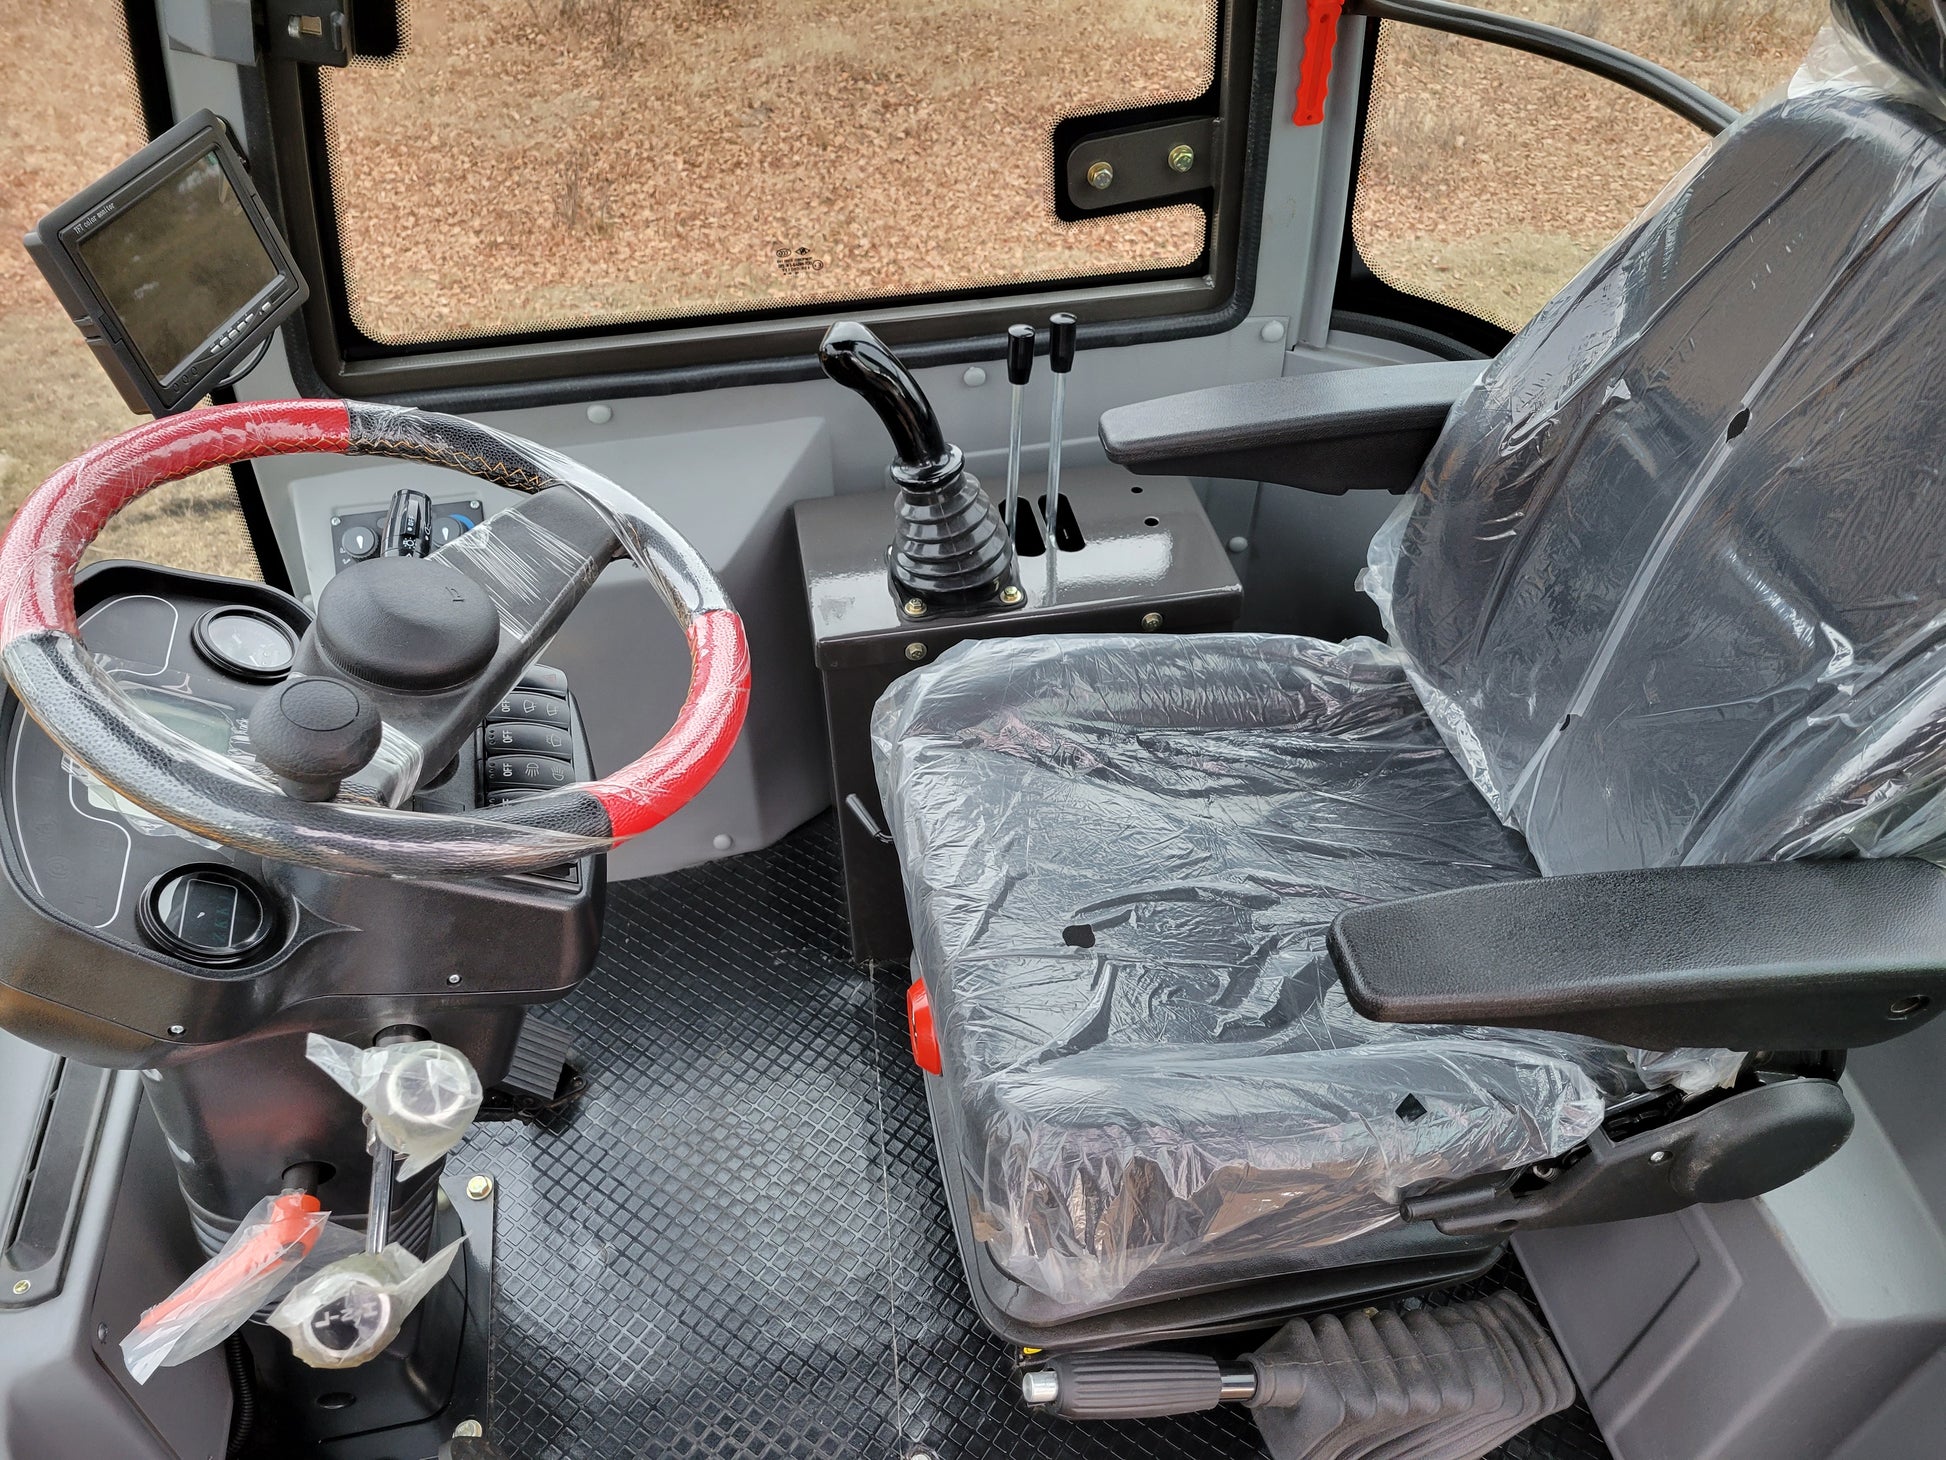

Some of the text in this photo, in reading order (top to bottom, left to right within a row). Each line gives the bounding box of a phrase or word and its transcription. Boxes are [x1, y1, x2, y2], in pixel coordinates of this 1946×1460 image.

[501, 700, 511, 713] OFF
[502, 729, 513, 744] OFF
[502, 762, 513, 777] OFF
